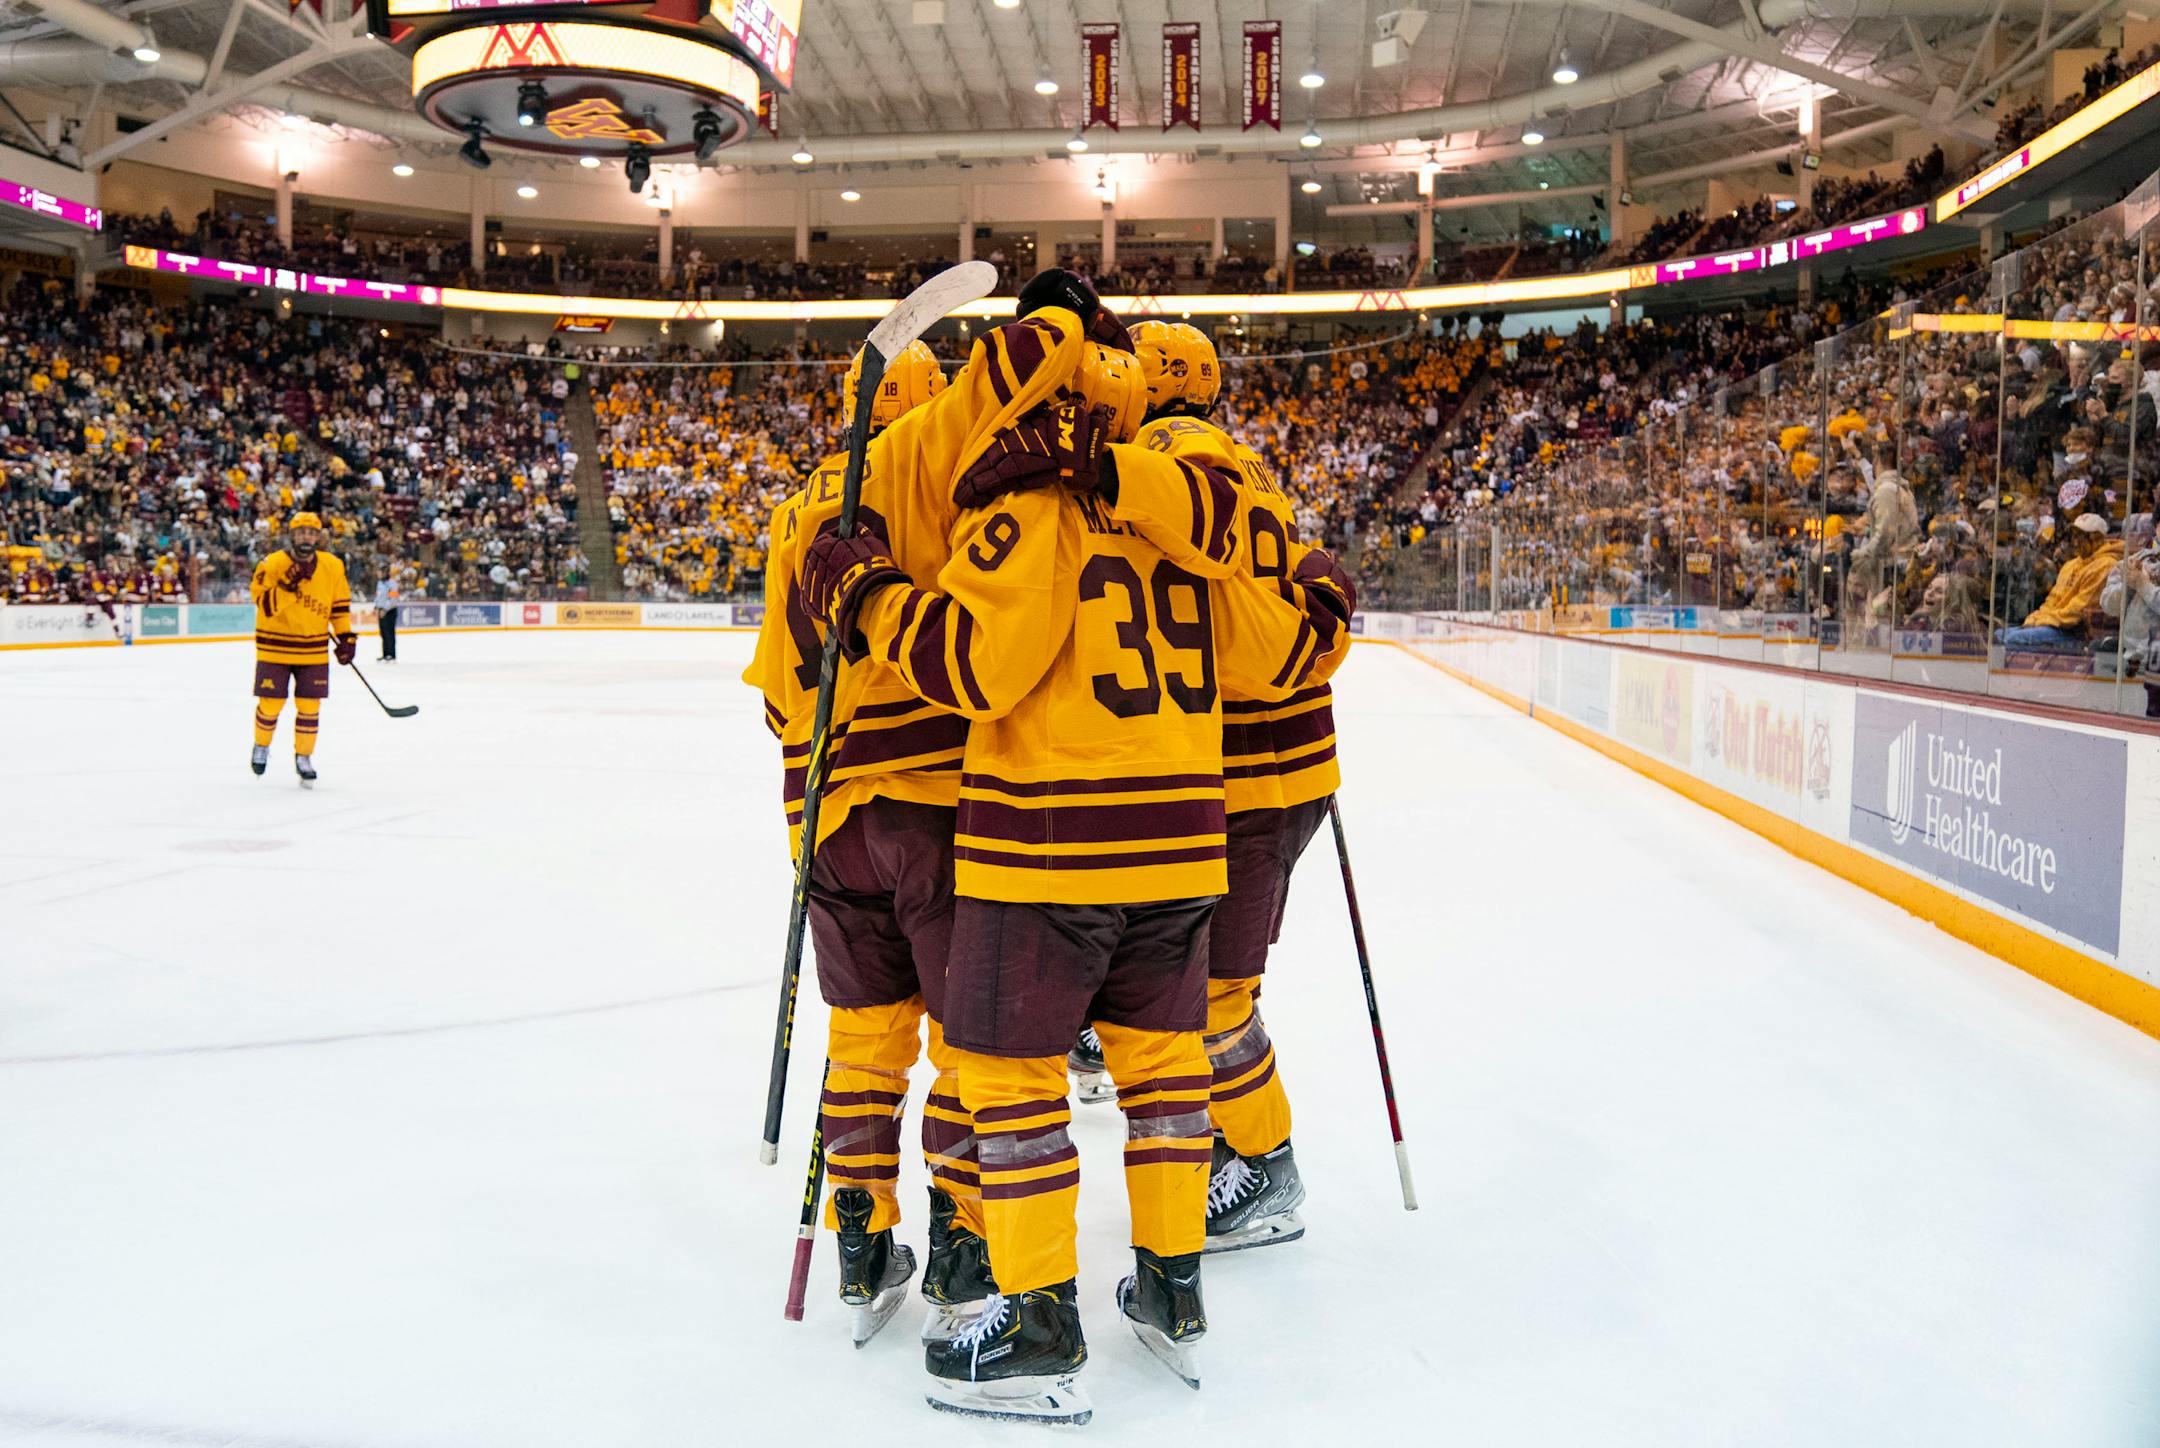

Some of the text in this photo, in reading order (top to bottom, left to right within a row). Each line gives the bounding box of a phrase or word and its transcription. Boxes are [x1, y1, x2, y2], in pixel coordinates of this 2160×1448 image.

[1095, 53, 1106, 106] 2003
[1110, 38, 1118, 122] CHAMPIONS
[1177, 53, 1188, 106] 2004
[1191, 38, 1199, 122] CHAMPIONS
[1257, 51, 1269, 104] 2007
[1272, 36, 1280, 120] CHAMPIONS
[884, 381, 898, 397] 18
[1200, 362, 1212, 378] 89
[1078, 554, 1218, 719] 39
[1927, 732, 2002, 806] United
[1922, 793, 2057, 894] Healthcare
[804, 1128, 822, 1206] CCM
